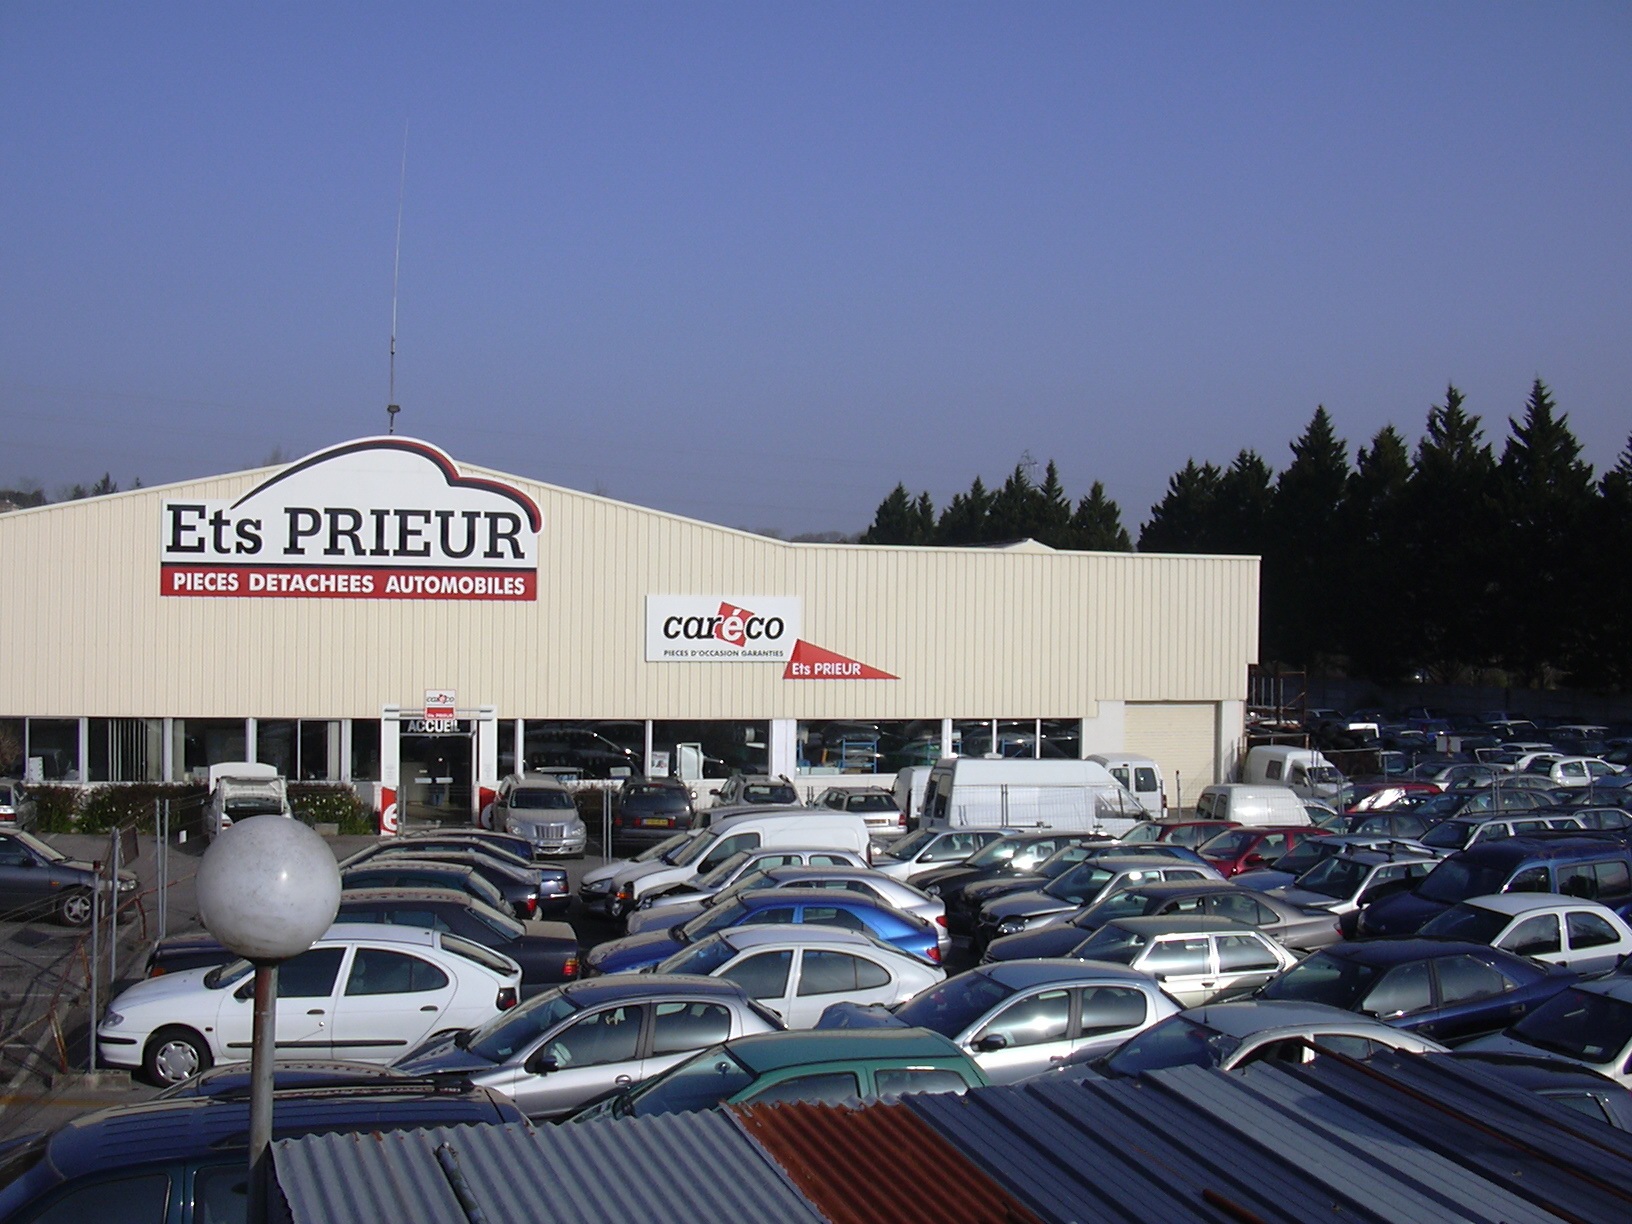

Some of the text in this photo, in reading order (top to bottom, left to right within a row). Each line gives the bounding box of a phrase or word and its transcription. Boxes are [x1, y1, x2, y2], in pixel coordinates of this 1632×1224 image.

[166, 504, 525, 559] Ets PRIEUR
[173, 572, 526, 595] PIECES DETACHEES AUTOMOBILES
[663, 609, 785, 641] caréco
[792, 663, 861, 675] Ets PRIEUR
[407, 719, 461, 733] ACCUEIL
